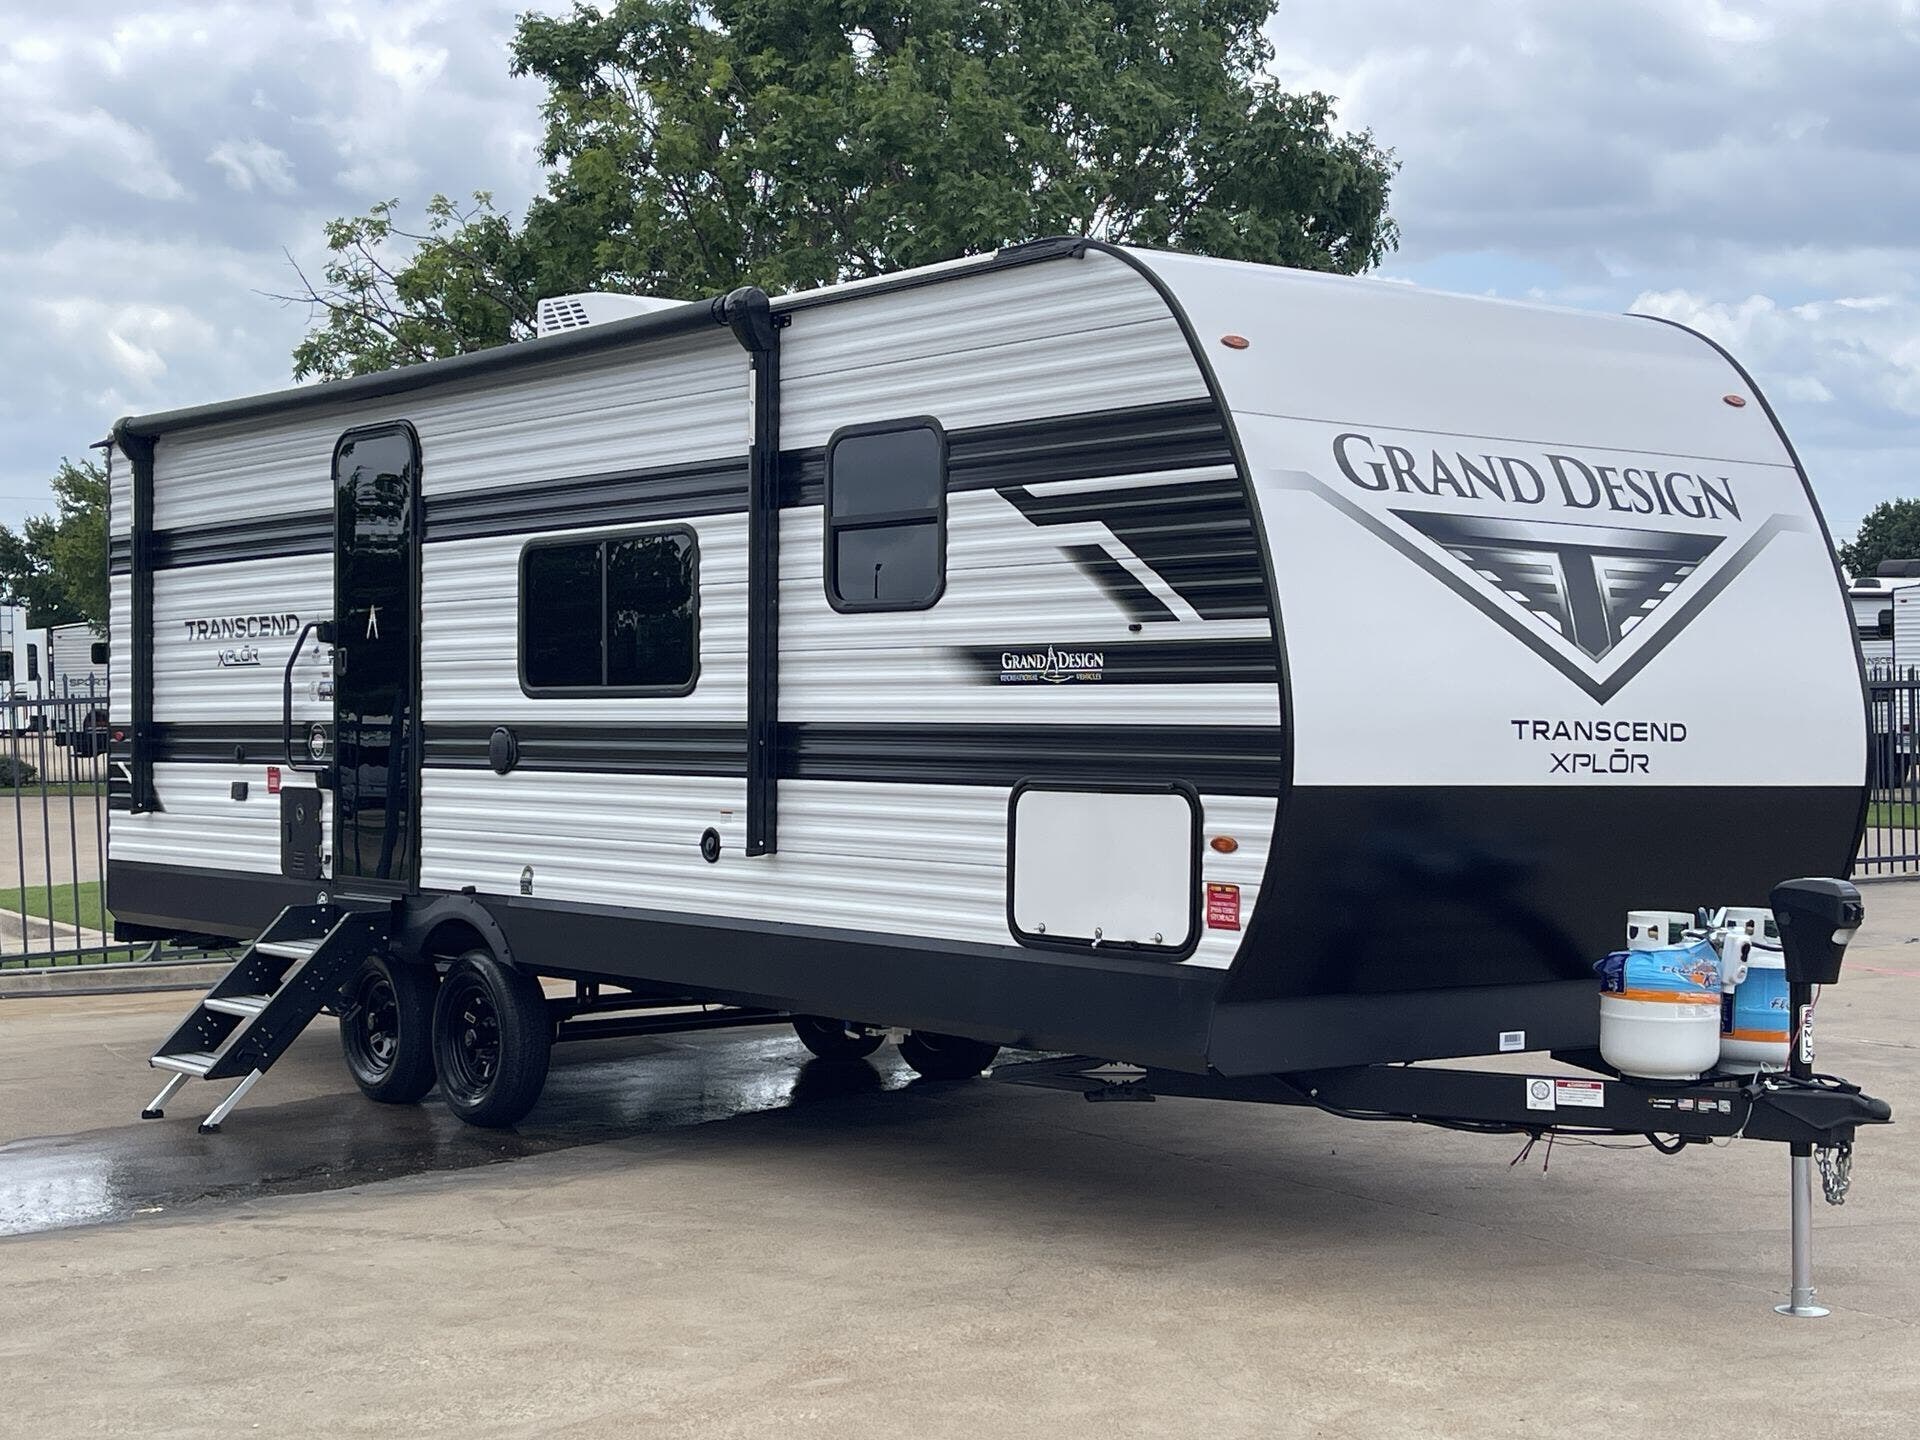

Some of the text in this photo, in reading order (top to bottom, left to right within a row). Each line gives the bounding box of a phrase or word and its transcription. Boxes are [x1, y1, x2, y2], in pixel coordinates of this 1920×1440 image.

[1333, 432, 1742, 522] GRAND DESIGN
[185, 614, 300, 641] TRANSCEND
[1001, 651, 1104, 669] GRAND DESIGN
[1510, 719, 1687, 742] TRANSCEND
[1550, 748, 1650, 774] XPLŌR
